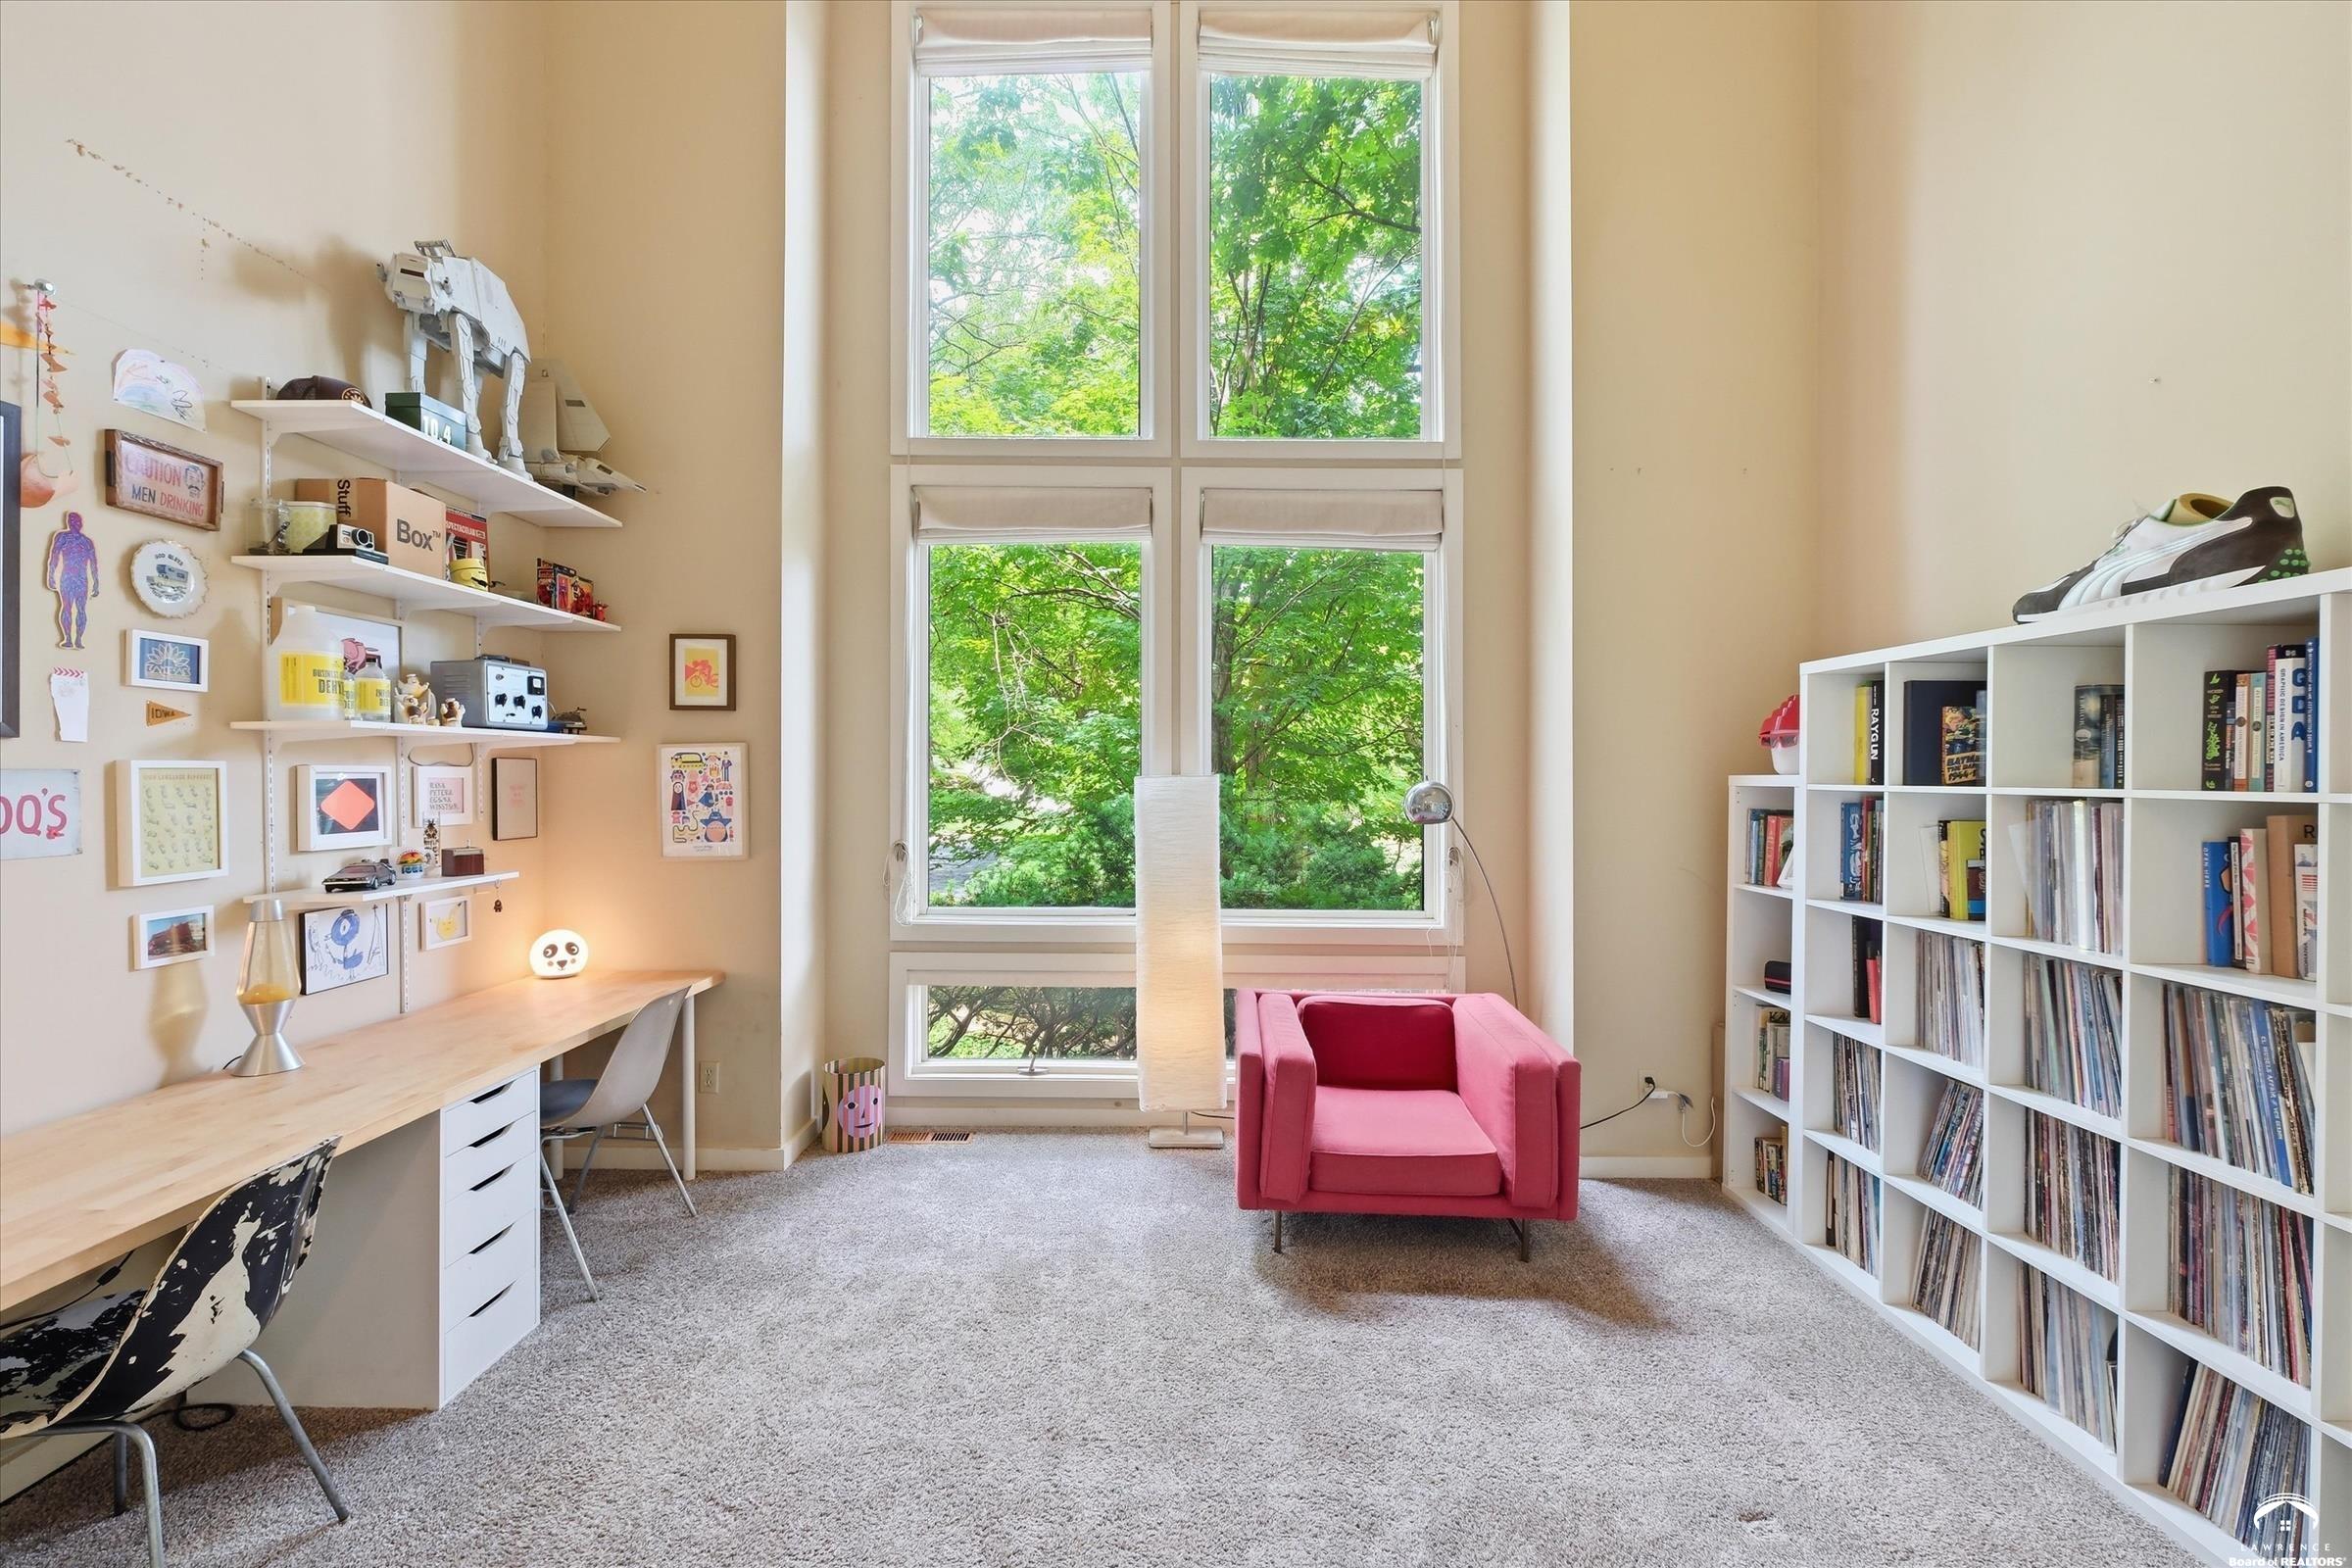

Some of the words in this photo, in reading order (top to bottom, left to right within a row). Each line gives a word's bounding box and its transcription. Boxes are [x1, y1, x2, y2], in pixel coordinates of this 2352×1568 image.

[125, 453, 181, 487] CAUTION
[131, 484, 156, 504] MEN
[160, 492, 205, 517] DRINKING
[337, 478, 351, 517] Stuff
[1870, 708, 1880, 760] RAYGUN
